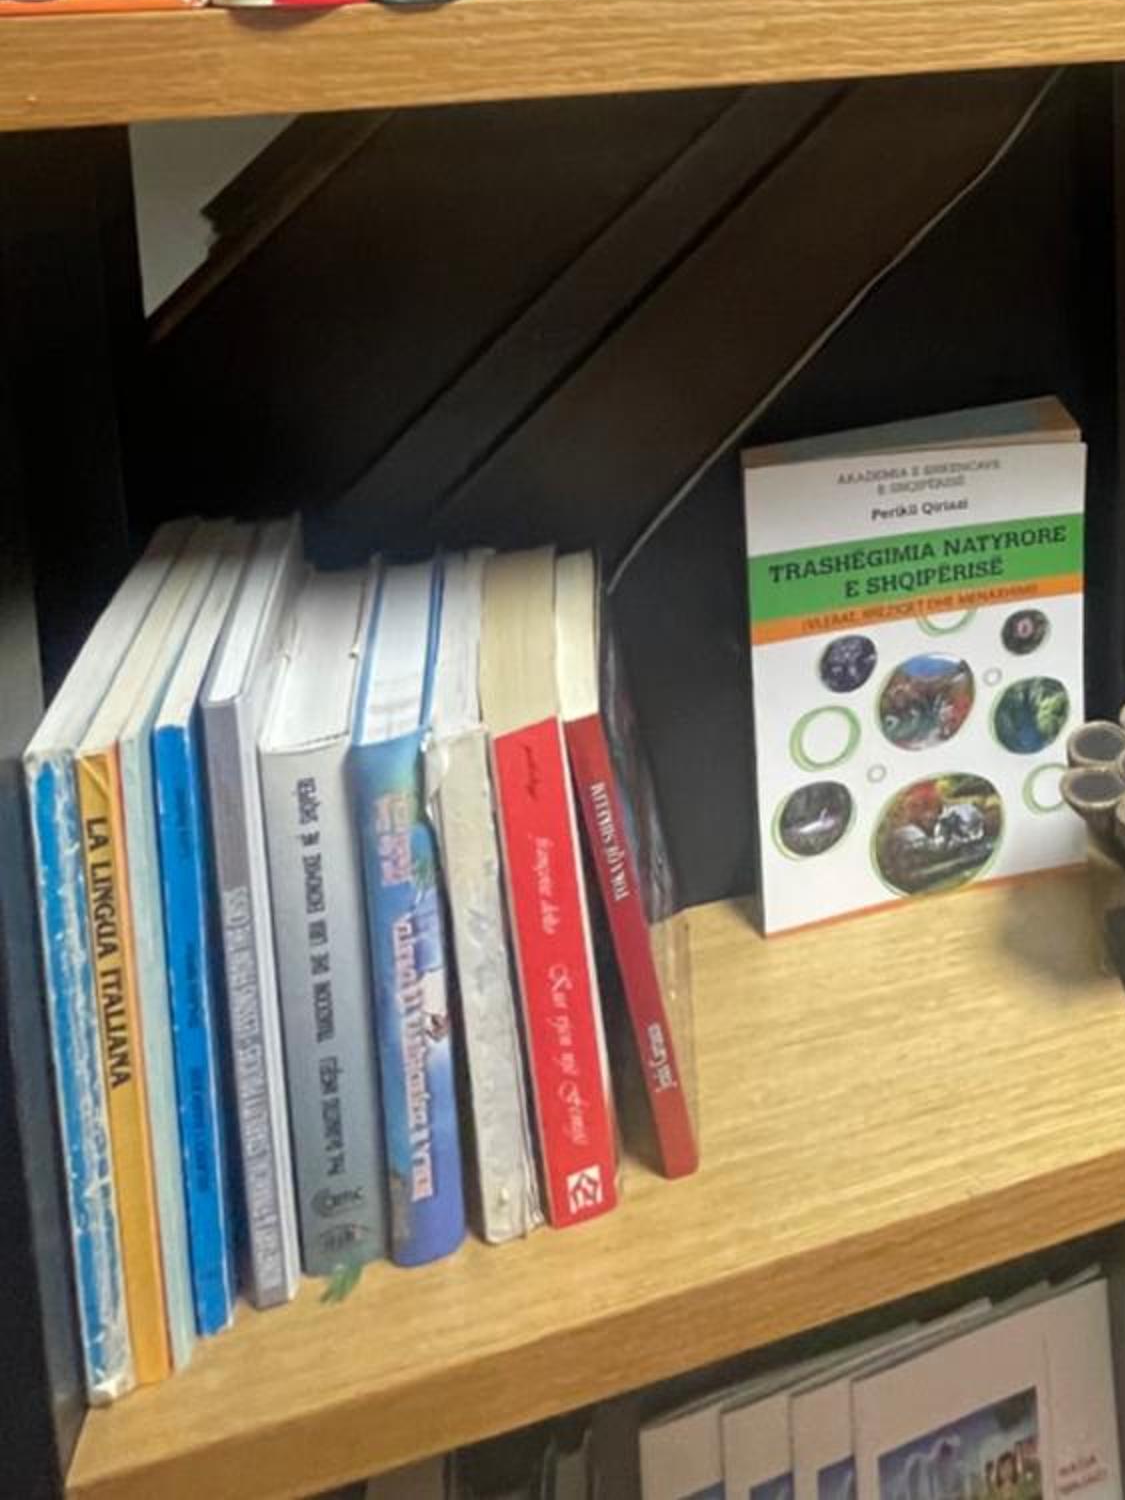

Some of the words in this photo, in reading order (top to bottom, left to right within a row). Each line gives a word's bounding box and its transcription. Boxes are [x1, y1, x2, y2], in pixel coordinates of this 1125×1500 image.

[870, 503, 918, 522] Perikli
[769, 540, 935, 584] TRASHËGIMIA
[943, 525, 1068, 560] NATYRORE
[845, 578, 861, 599] E
[868, 557, 1005, 594] SHQIPËRISË
[85, 817, 110, 852] LA
[90, 861, 118, 959] LINGUA
[100, 966, 133, 1088] ITALIANA
